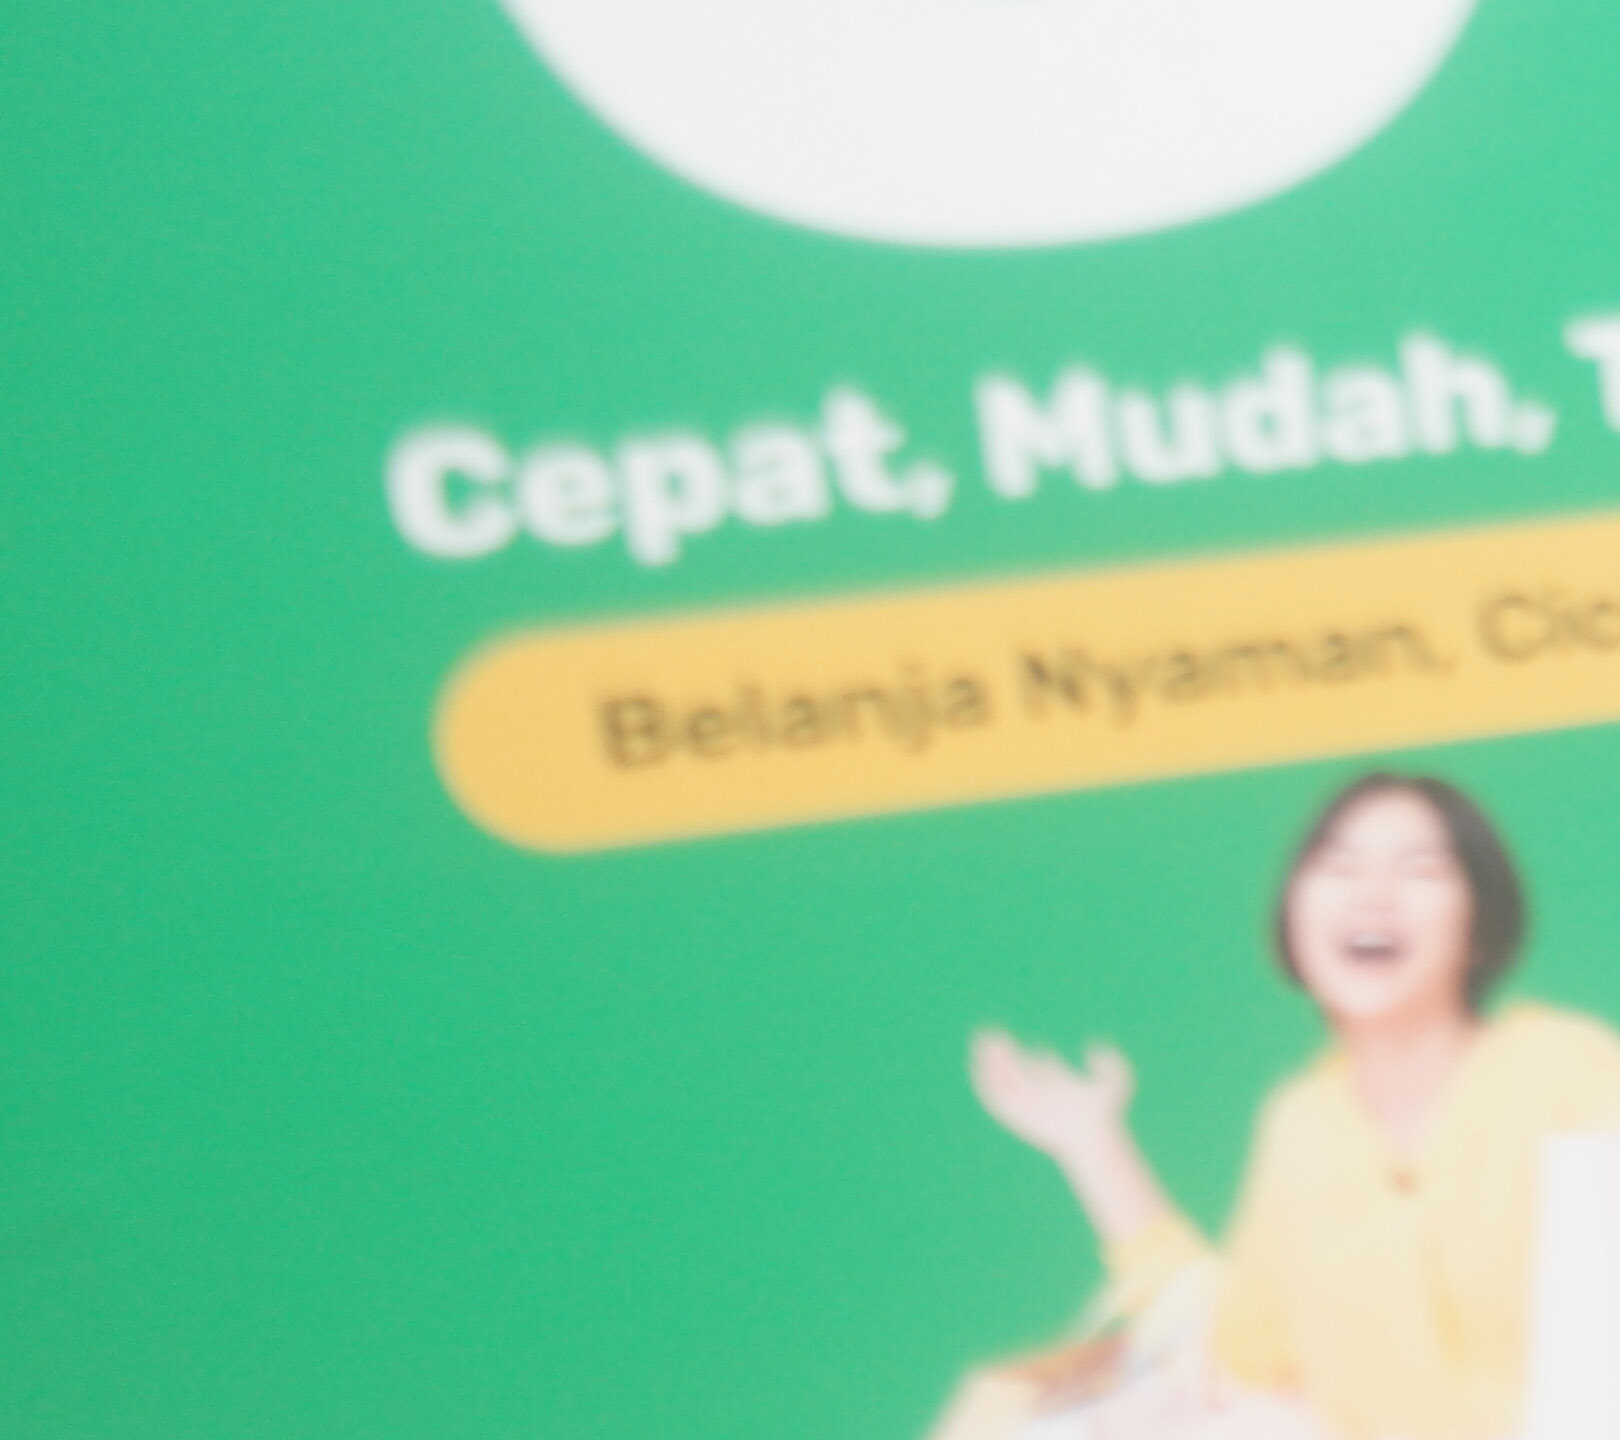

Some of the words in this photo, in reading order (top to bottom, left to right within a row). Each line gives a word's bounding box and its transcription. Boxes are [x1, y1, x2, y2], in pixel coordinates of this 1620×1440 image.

[387, 385, 950, 564] Cepat,
[973, 336, 1554, 505] Mudah,
[593, 629, 997, 783] Belanja
[1019, 598, 1458, 730] Nyaman,
